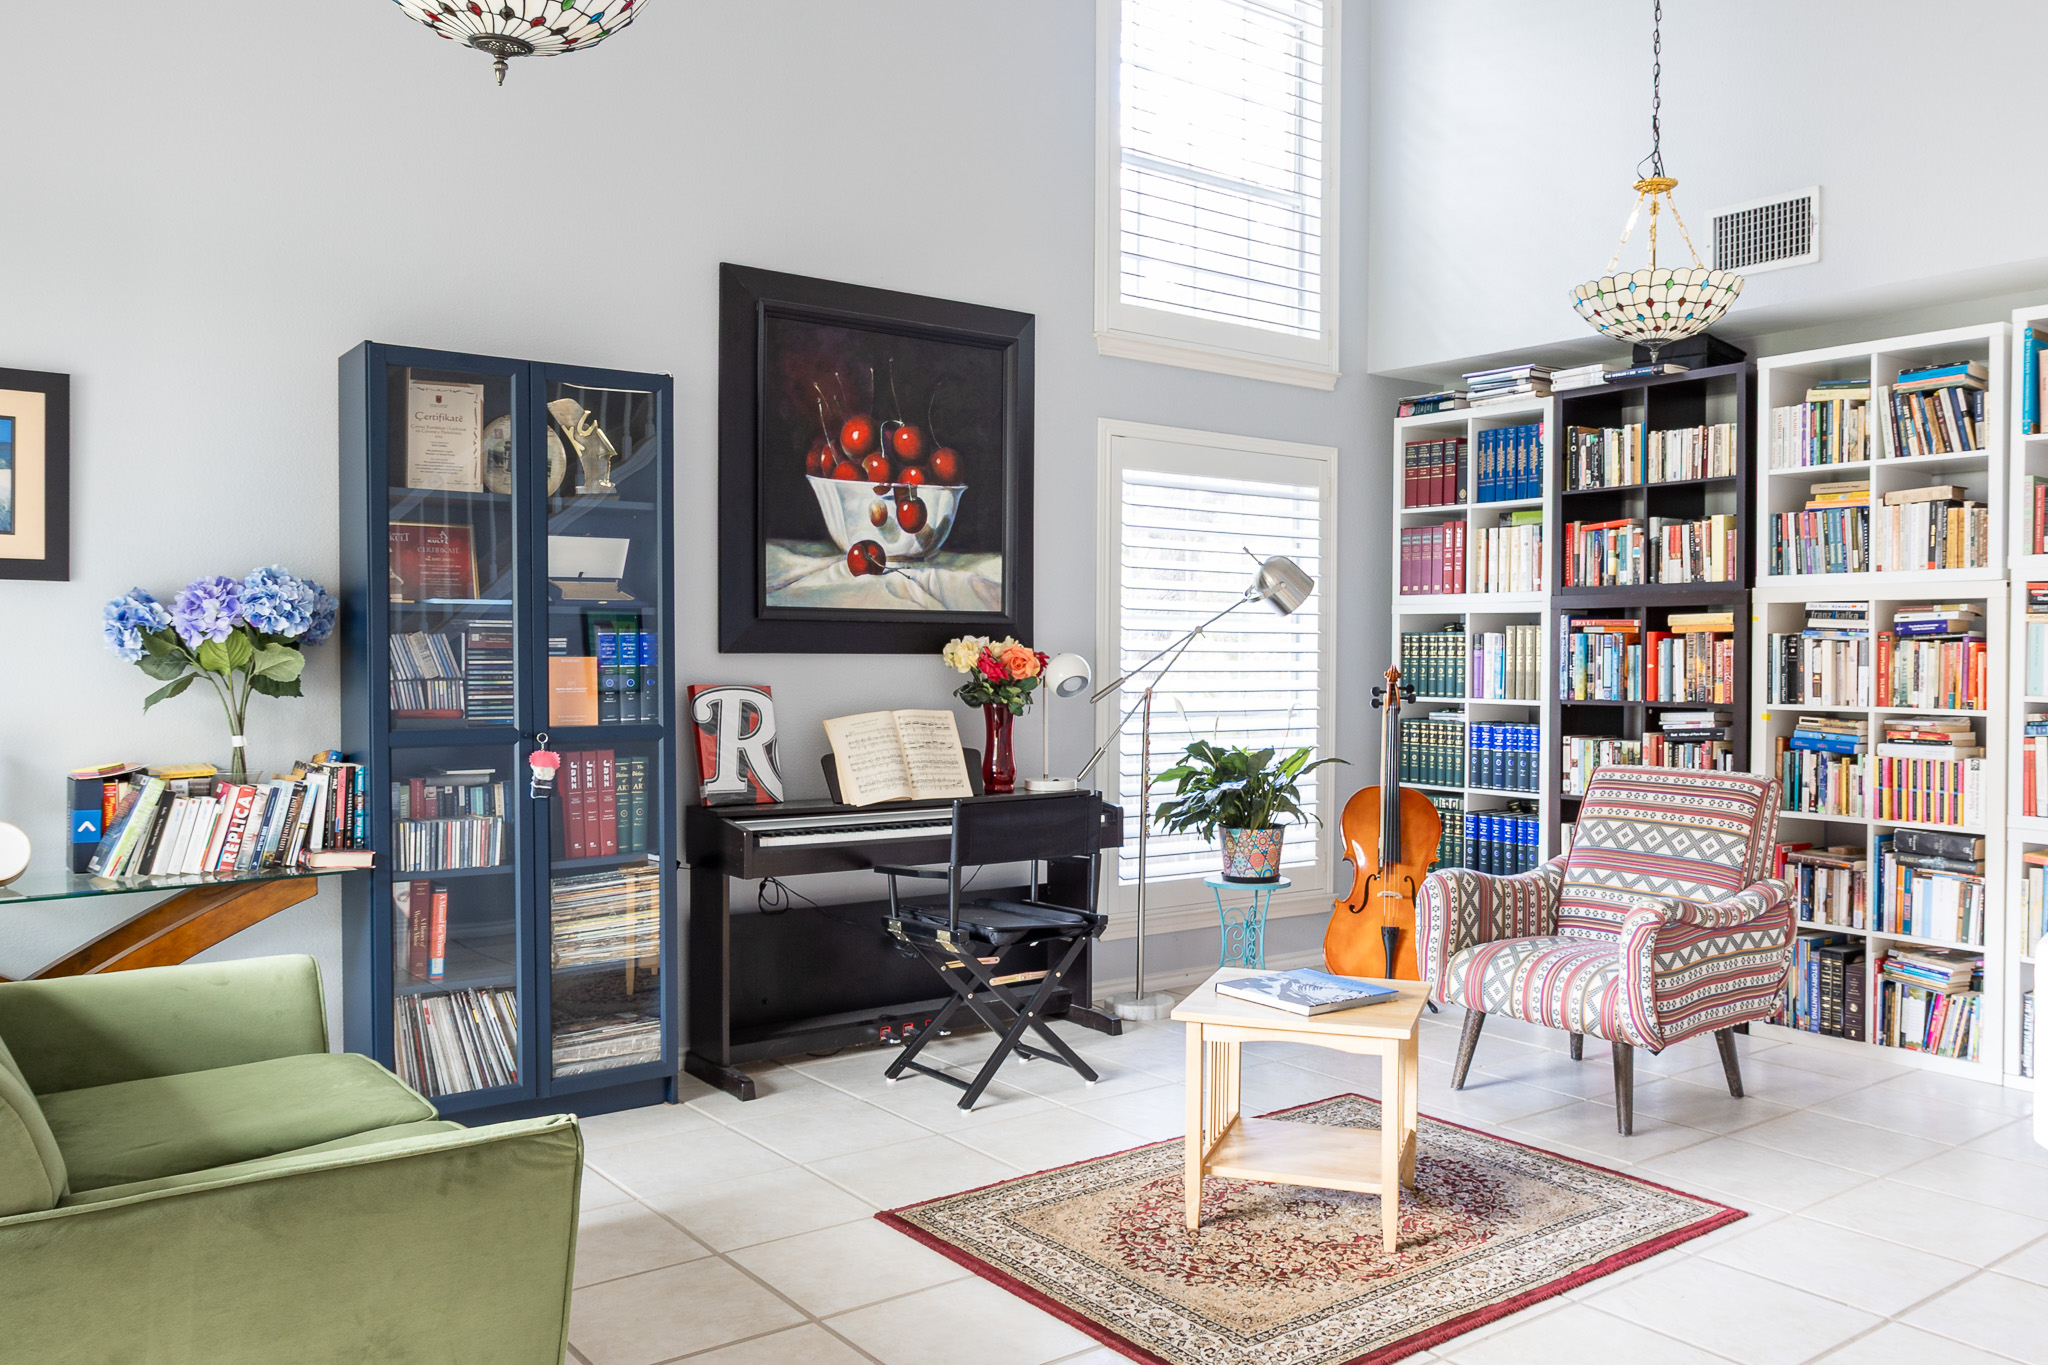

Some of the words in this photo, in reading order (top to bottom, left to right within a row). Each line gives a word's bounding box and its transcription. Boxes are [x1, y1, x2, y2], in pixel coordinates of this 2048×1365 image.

[415, 411, 463, 422] Çertifikatë
[1811, 611, 1832, 619] franz
[1835, 612, 1858, 620] kafka
[690, 686, 784, 802] R
[221, 798, 255, 865] REPLICA
[278, 795, 300, 852] pandemonium
